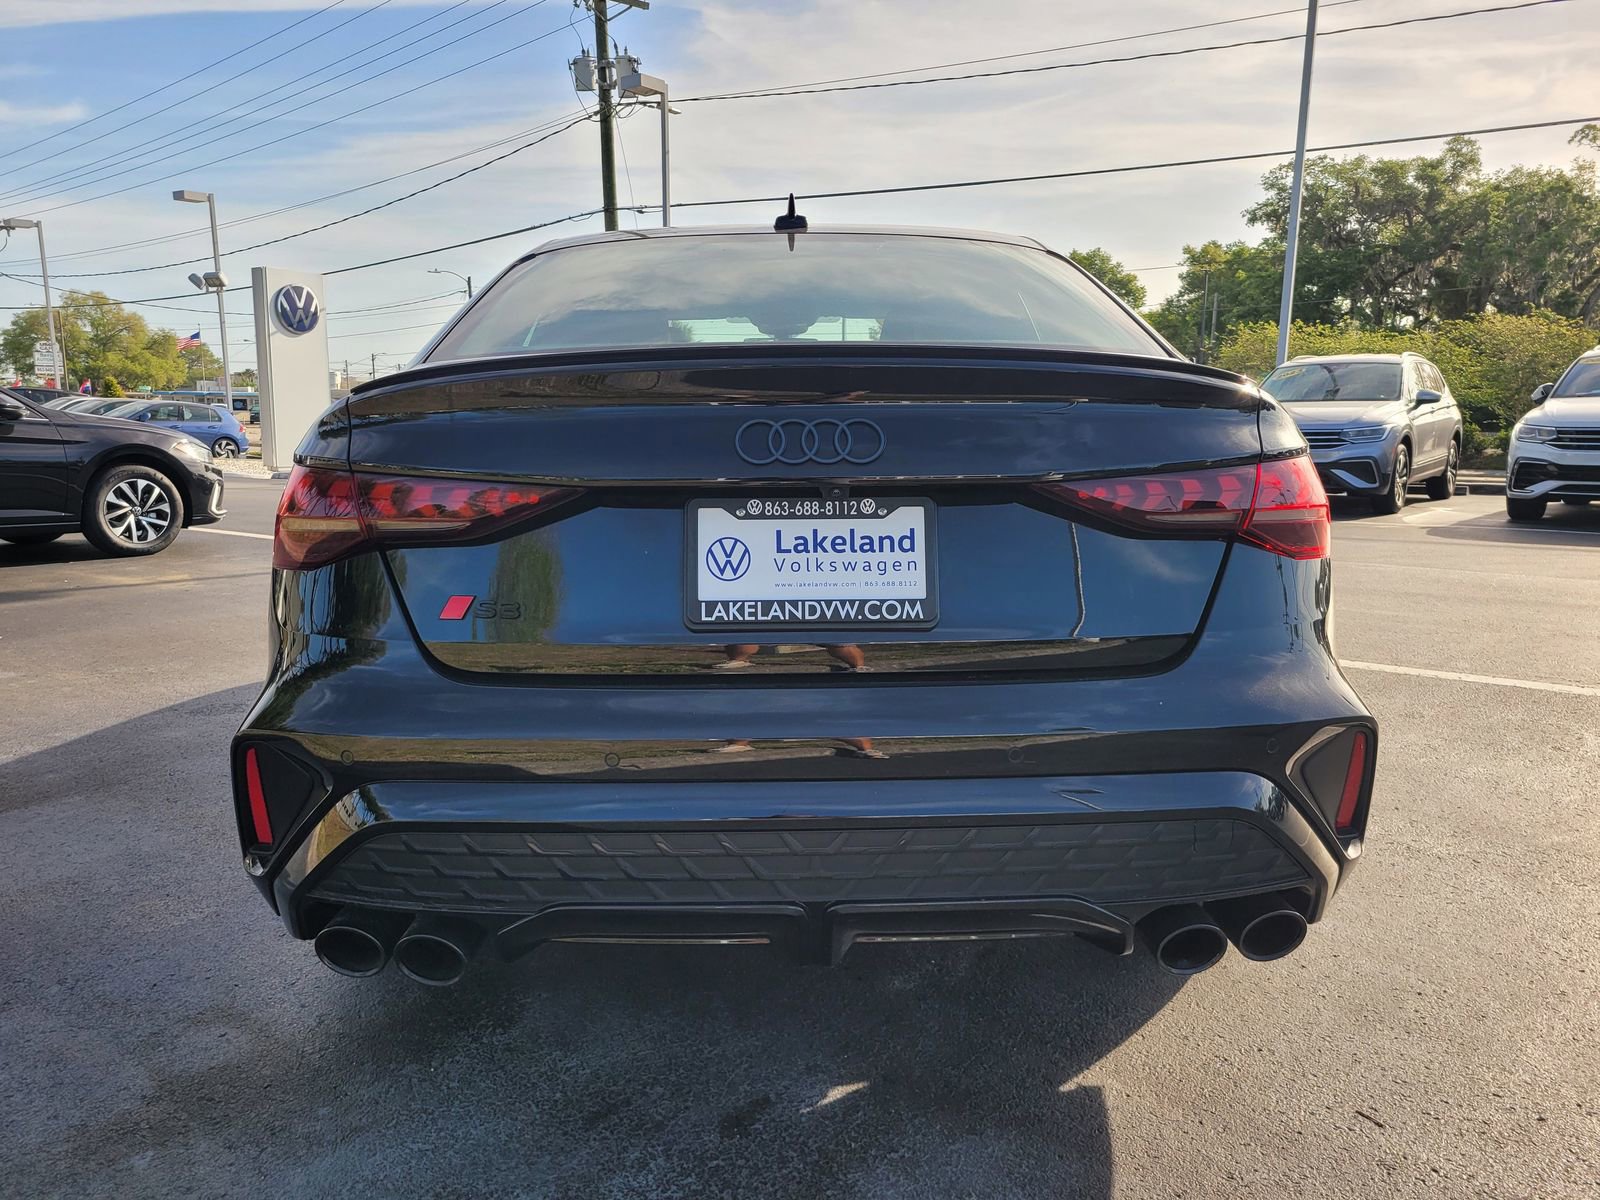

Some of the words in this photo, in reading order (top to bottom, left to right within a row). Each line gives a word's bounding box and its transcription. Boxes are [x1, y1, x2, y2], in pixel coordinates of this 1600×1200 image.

[765, 501, 858, 515] 863-688-8112
[775, 528, 916, 554] Lakeland
[774, 557, 917, 575] Volkswagen
[774, 580, 857, 588] www.lakelandvw.com
[475, 600, 521, 619] S3
[701, 600, 924, 620] LAKELANDVW.COM
